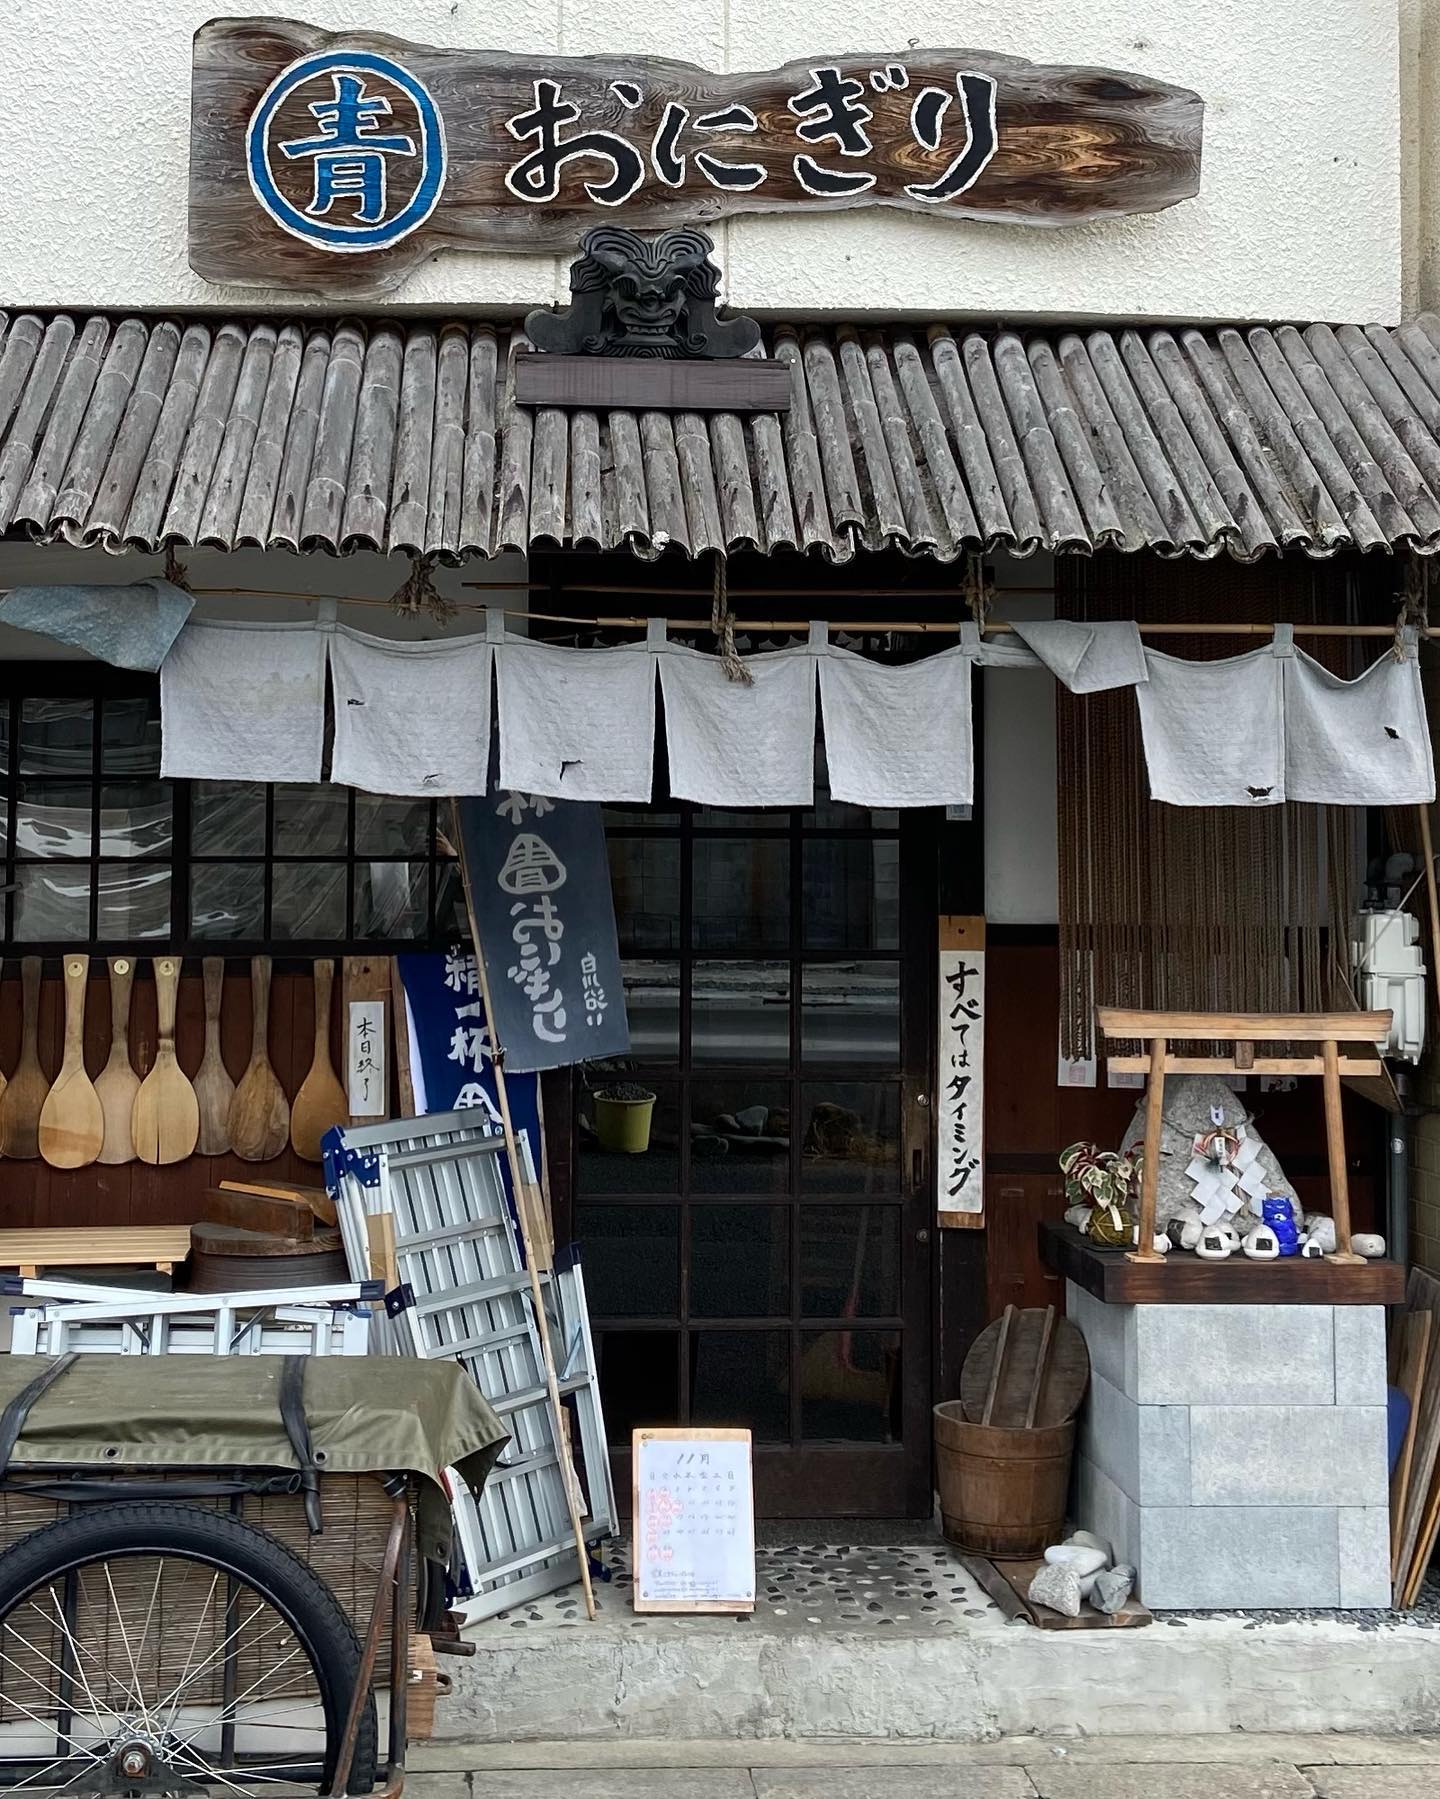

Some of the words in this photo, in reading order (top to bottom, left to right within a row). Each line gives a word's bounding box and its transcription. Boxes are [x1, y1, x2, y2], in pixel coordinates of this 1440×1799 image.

[278, 68, 417, 224] 青
[505, 64, 998, 206] おにぎり
[356, 1017, 381, 1102] 本日終了
[945, 961, 983, 1197] すべてはタイミング
